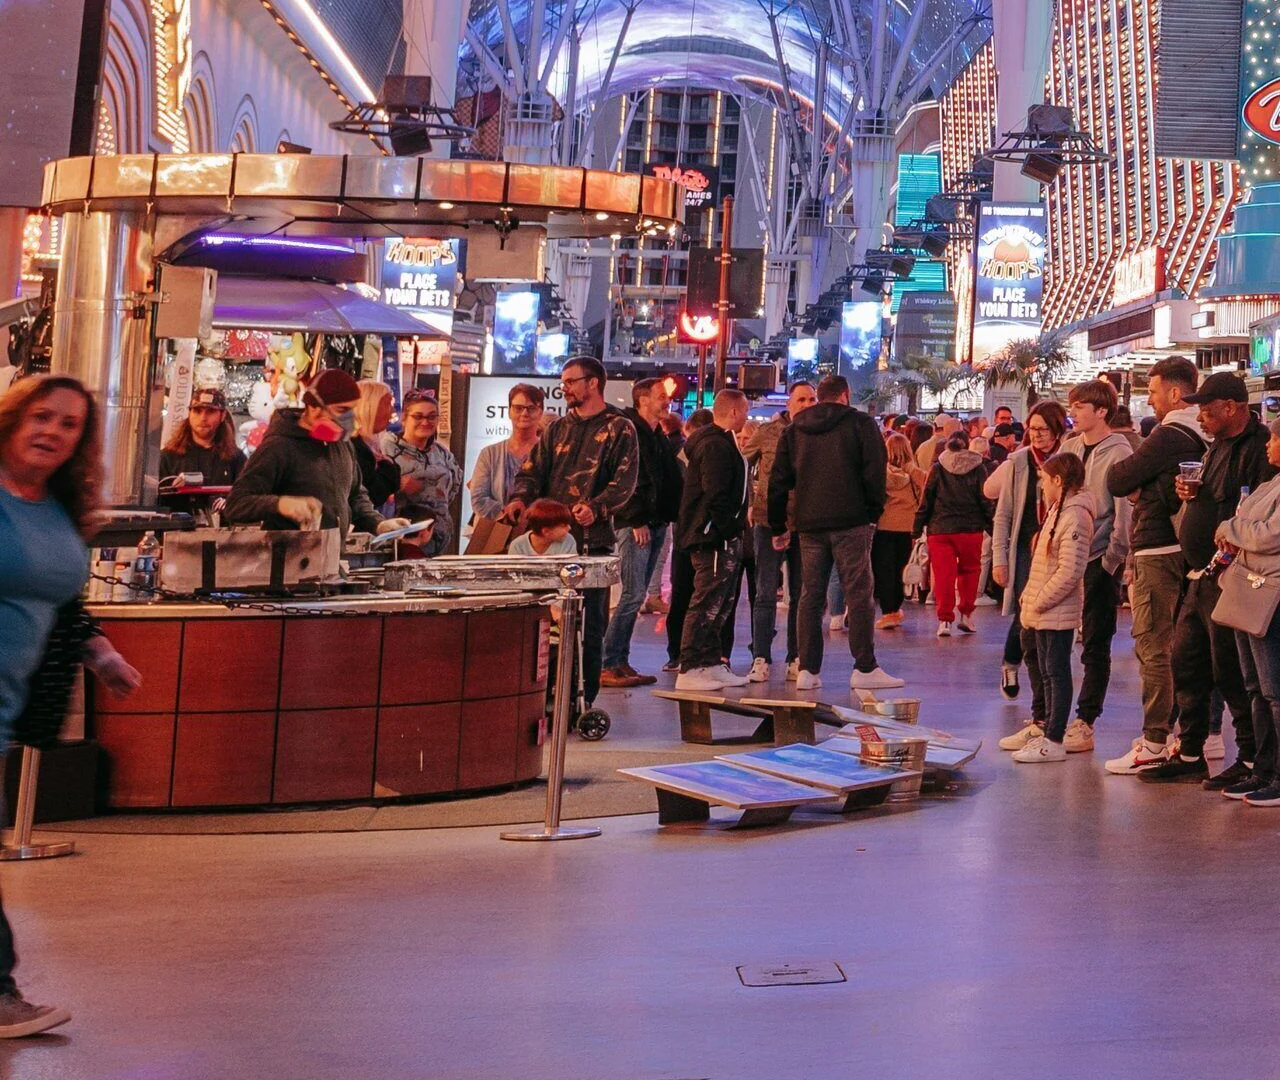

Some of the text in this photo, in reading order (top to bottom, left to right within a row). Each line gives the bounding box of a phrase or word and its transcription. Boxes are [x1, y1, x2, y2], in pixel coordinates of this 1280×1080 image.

[686, 191, 712, 200] AMES
[386, 241, 456, 267] HOOPS
[980, 258, 1042, 281] HOOPS
[400, 273, 438, 290] PLACE
[385, 288, 450, 307] YOUR BETS
[993, 287, 1026, 302] PLACE
[980, 303, 1038, 318] YOUR BETS
